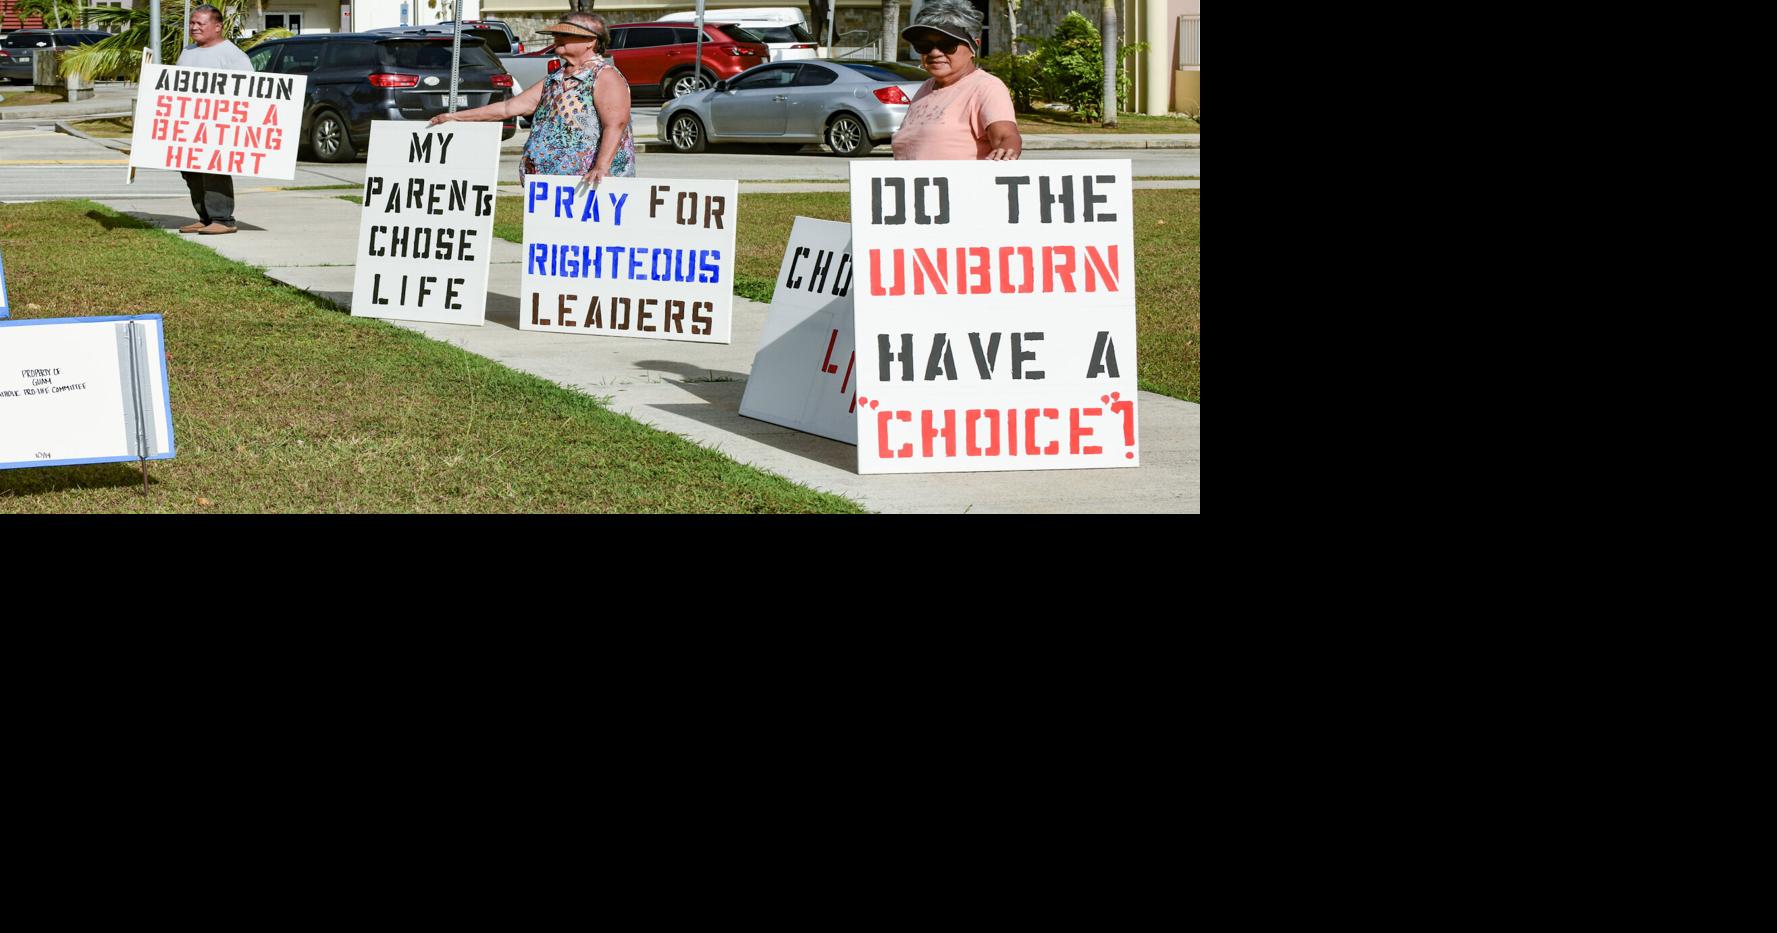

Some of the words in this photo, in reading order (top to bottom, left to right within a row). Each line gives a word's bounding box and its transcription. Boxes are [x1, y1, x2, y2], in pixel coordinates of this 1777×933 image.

[155, 69, 294, 101] ABORTION
[155, 95, 250, 124] STOPS
[263, 104, 279, 127] A
[152, 118, 283, 151] BEATING
[408, 132, 454, 165] MY
[166, 145, 266, 175] HEART
[528, 181, 629, 226] PRAY
[649, 185, 726, 230] FOR
[871, 176, 950, 225] DO
[995, 175, 1118, 223] THE
[368, 225, 478, 262] CHOSE
[528, 242, 721, 284] RIGHTEOUS
[869, 245, 1119, 296] UNBORN
[372, 273, 465, 310] LIFE
[531, 292, 714, 336] LEADERS
[877, 331, 1046, 382] HAVE
[1086, 331, 1121, 379] A
[32, 377, 52, 386] GUAM
